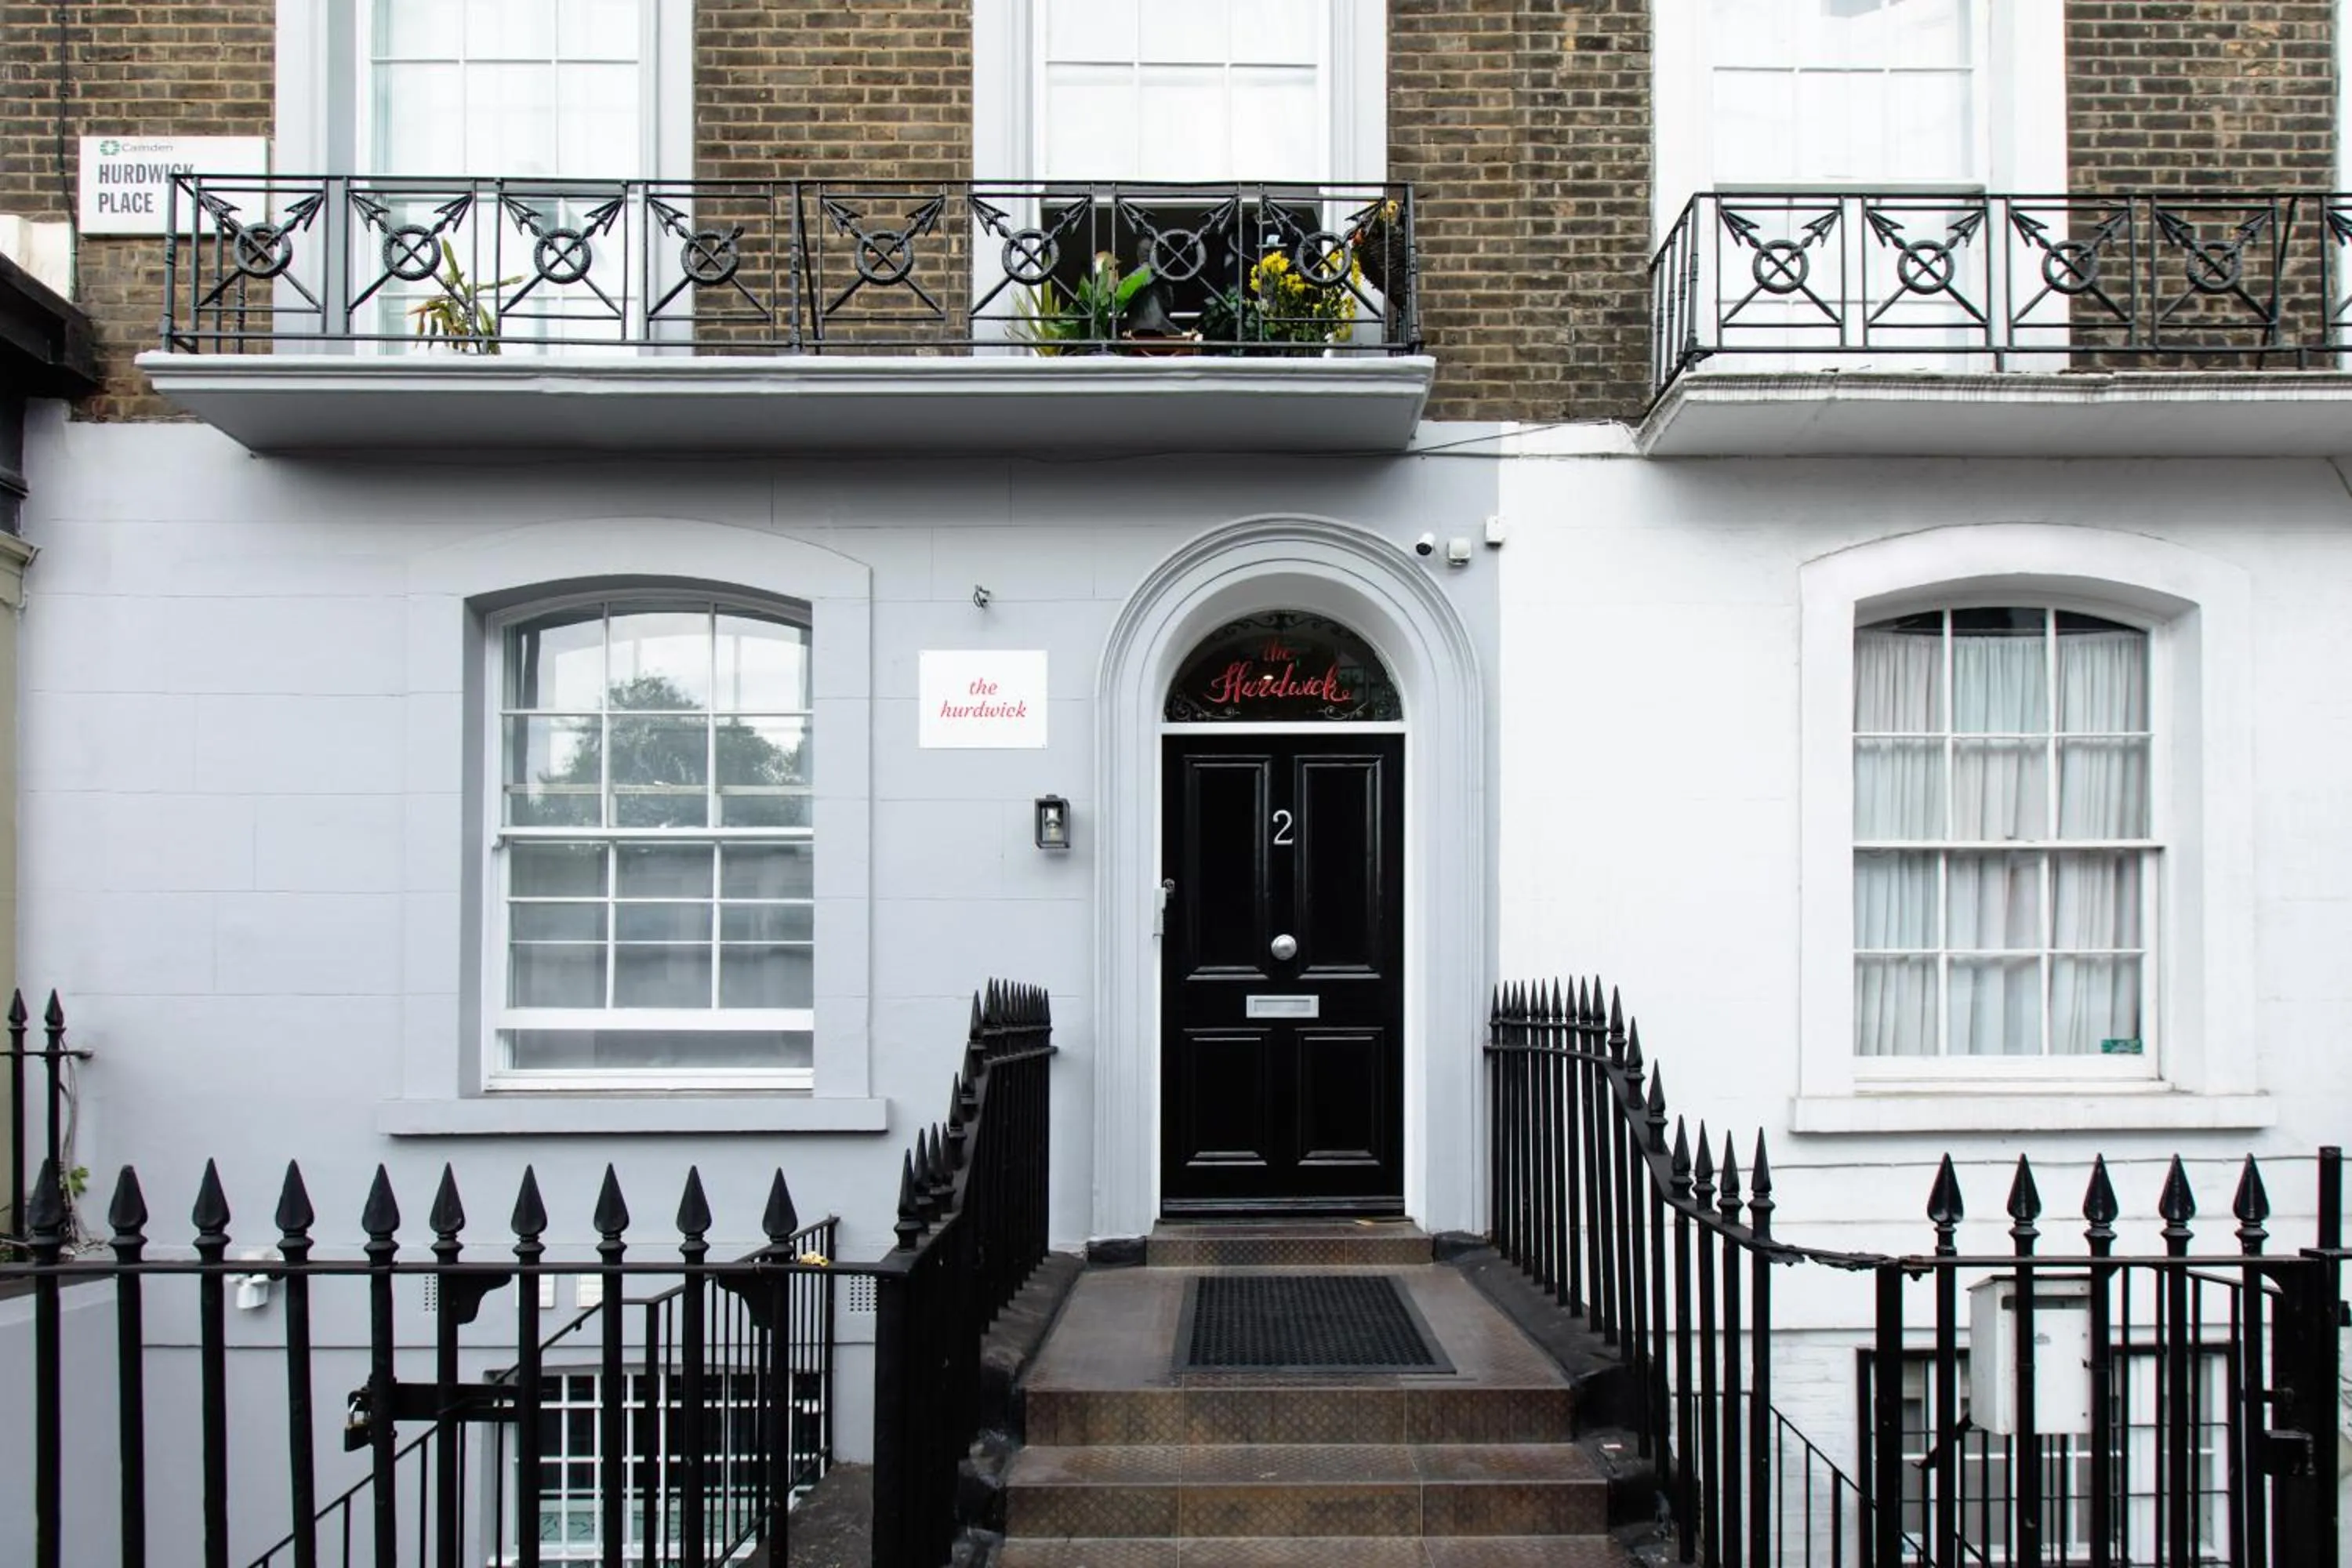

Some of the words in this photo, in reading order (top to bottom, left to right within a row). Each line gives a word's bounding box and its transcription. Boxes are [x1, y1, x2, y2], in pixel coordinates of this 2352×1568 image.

[122, 143, 174, 152] Camden
[98, 192, 154, 213] PLACE
[969, 677, 998, 695] the
[940, 699, 1027, 718] hurdwick
[1272, 810, 1294, 845] 2
